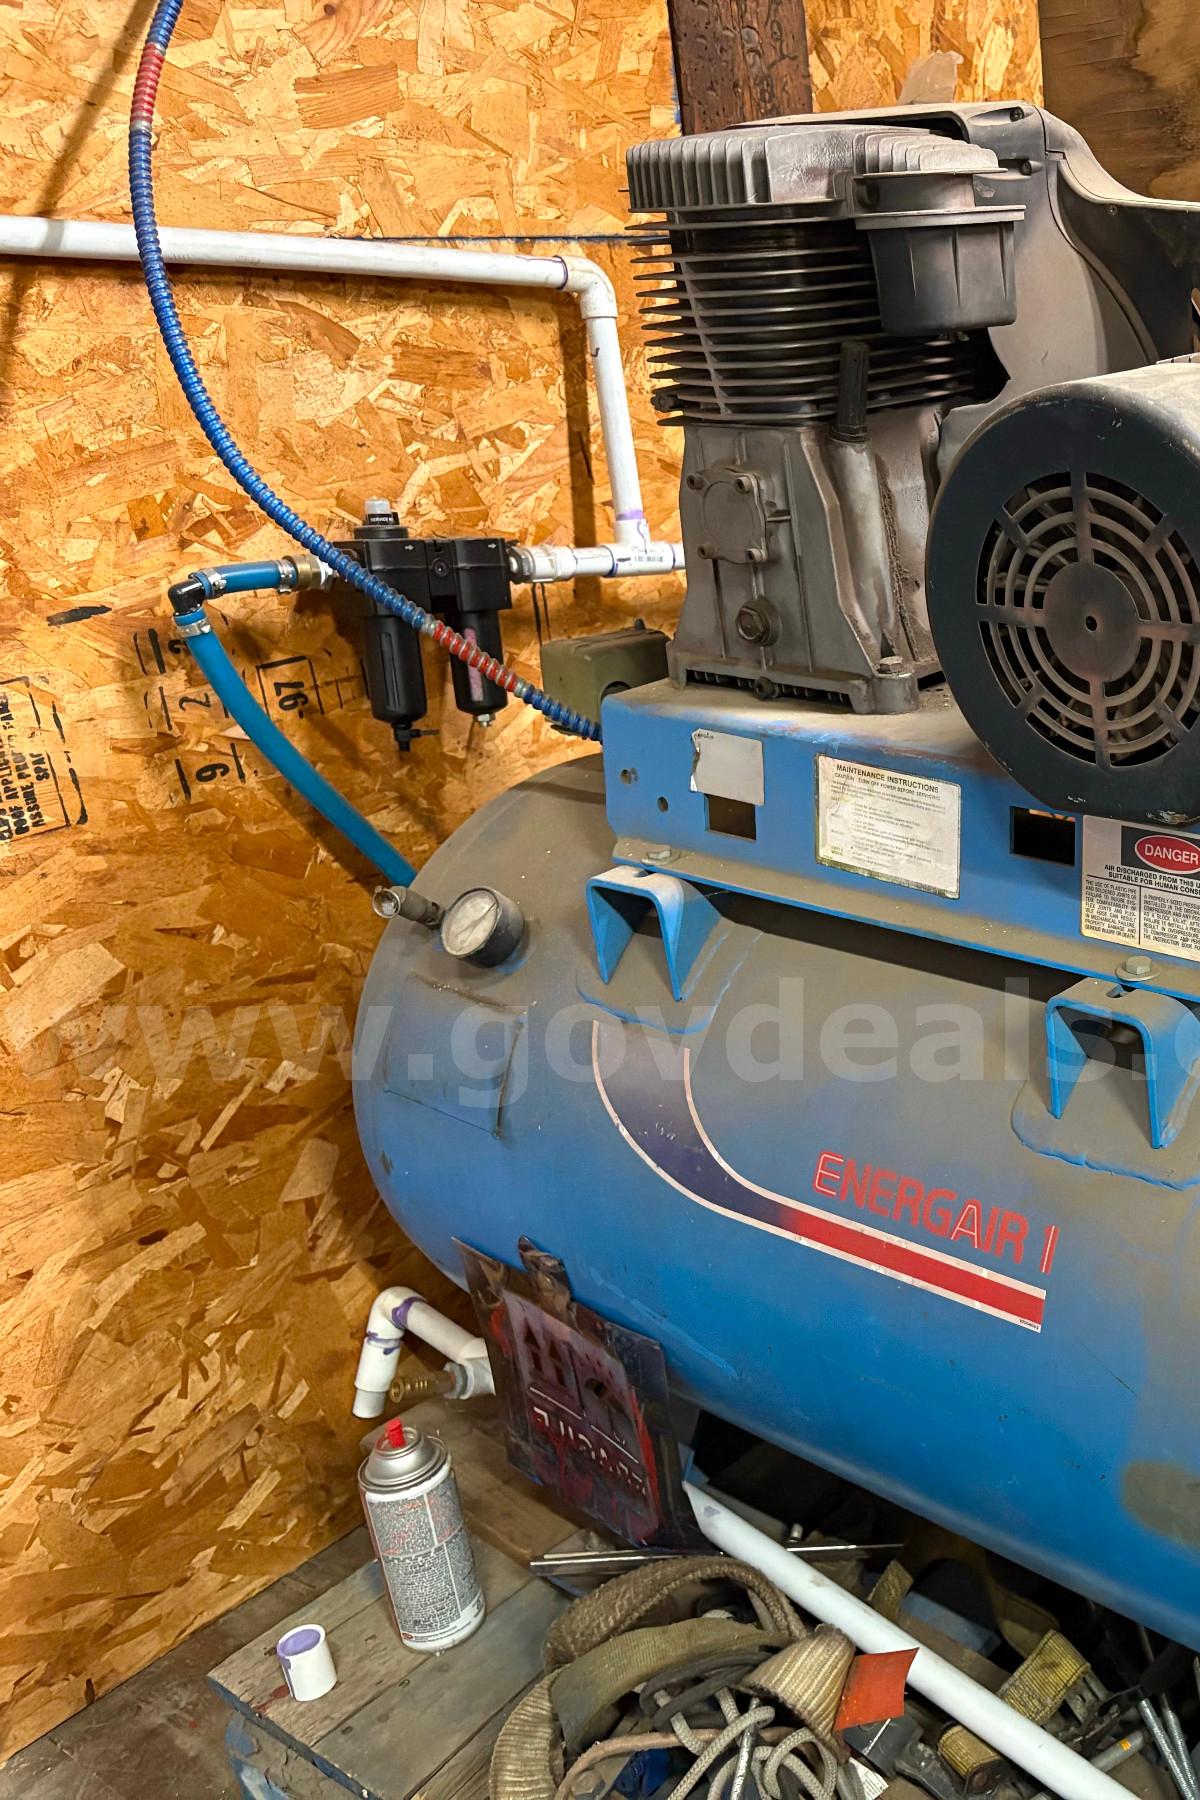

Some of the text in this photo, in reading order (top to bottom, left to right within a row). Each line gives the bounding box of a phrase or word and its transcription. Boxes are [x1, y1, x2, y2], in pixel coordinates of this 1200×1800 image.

[837, 764, 939, 793] MAINTENANCE INSTRUCTIONS
[21, 782, 46, 828] ASSURE
[1145, 844, 1199, 865] DANGER
[1109, 871, 1138, 883] SUITABLE
[1141, 878, 1153, 886] FOR
[1155, 880, 1178, 891] HUMAN
[1117, 866, 1157, 880] DISCHARGED
[1159, 875, 1178, 884] FROM
[1180, 879, 1194, 887] THIS
[812, 1151, 1029, 1270] ENERGAIR
